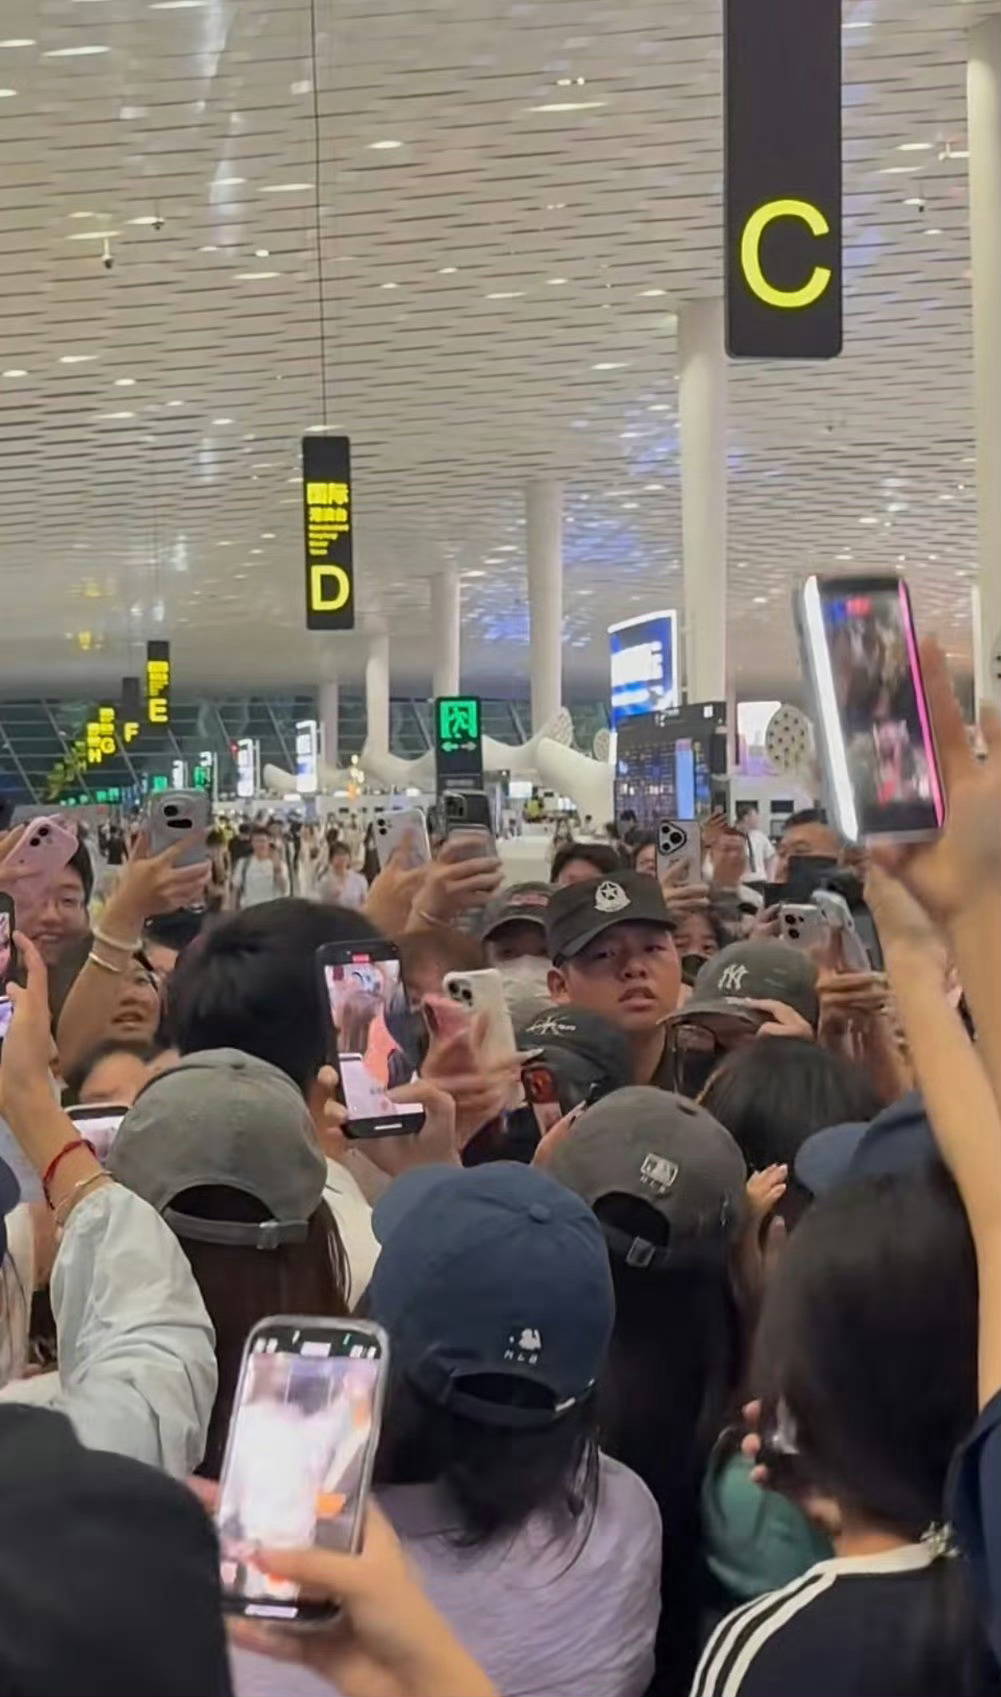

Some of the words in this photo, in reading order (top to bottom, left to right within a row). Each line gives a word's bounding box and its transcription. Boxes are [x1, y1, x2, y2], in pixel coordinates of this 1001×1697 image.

[741, 199, 831, 307] C
[311, 564, 350, 610] D
[149, 698, 168, 722] E
[124, 722, 139, 742] F
